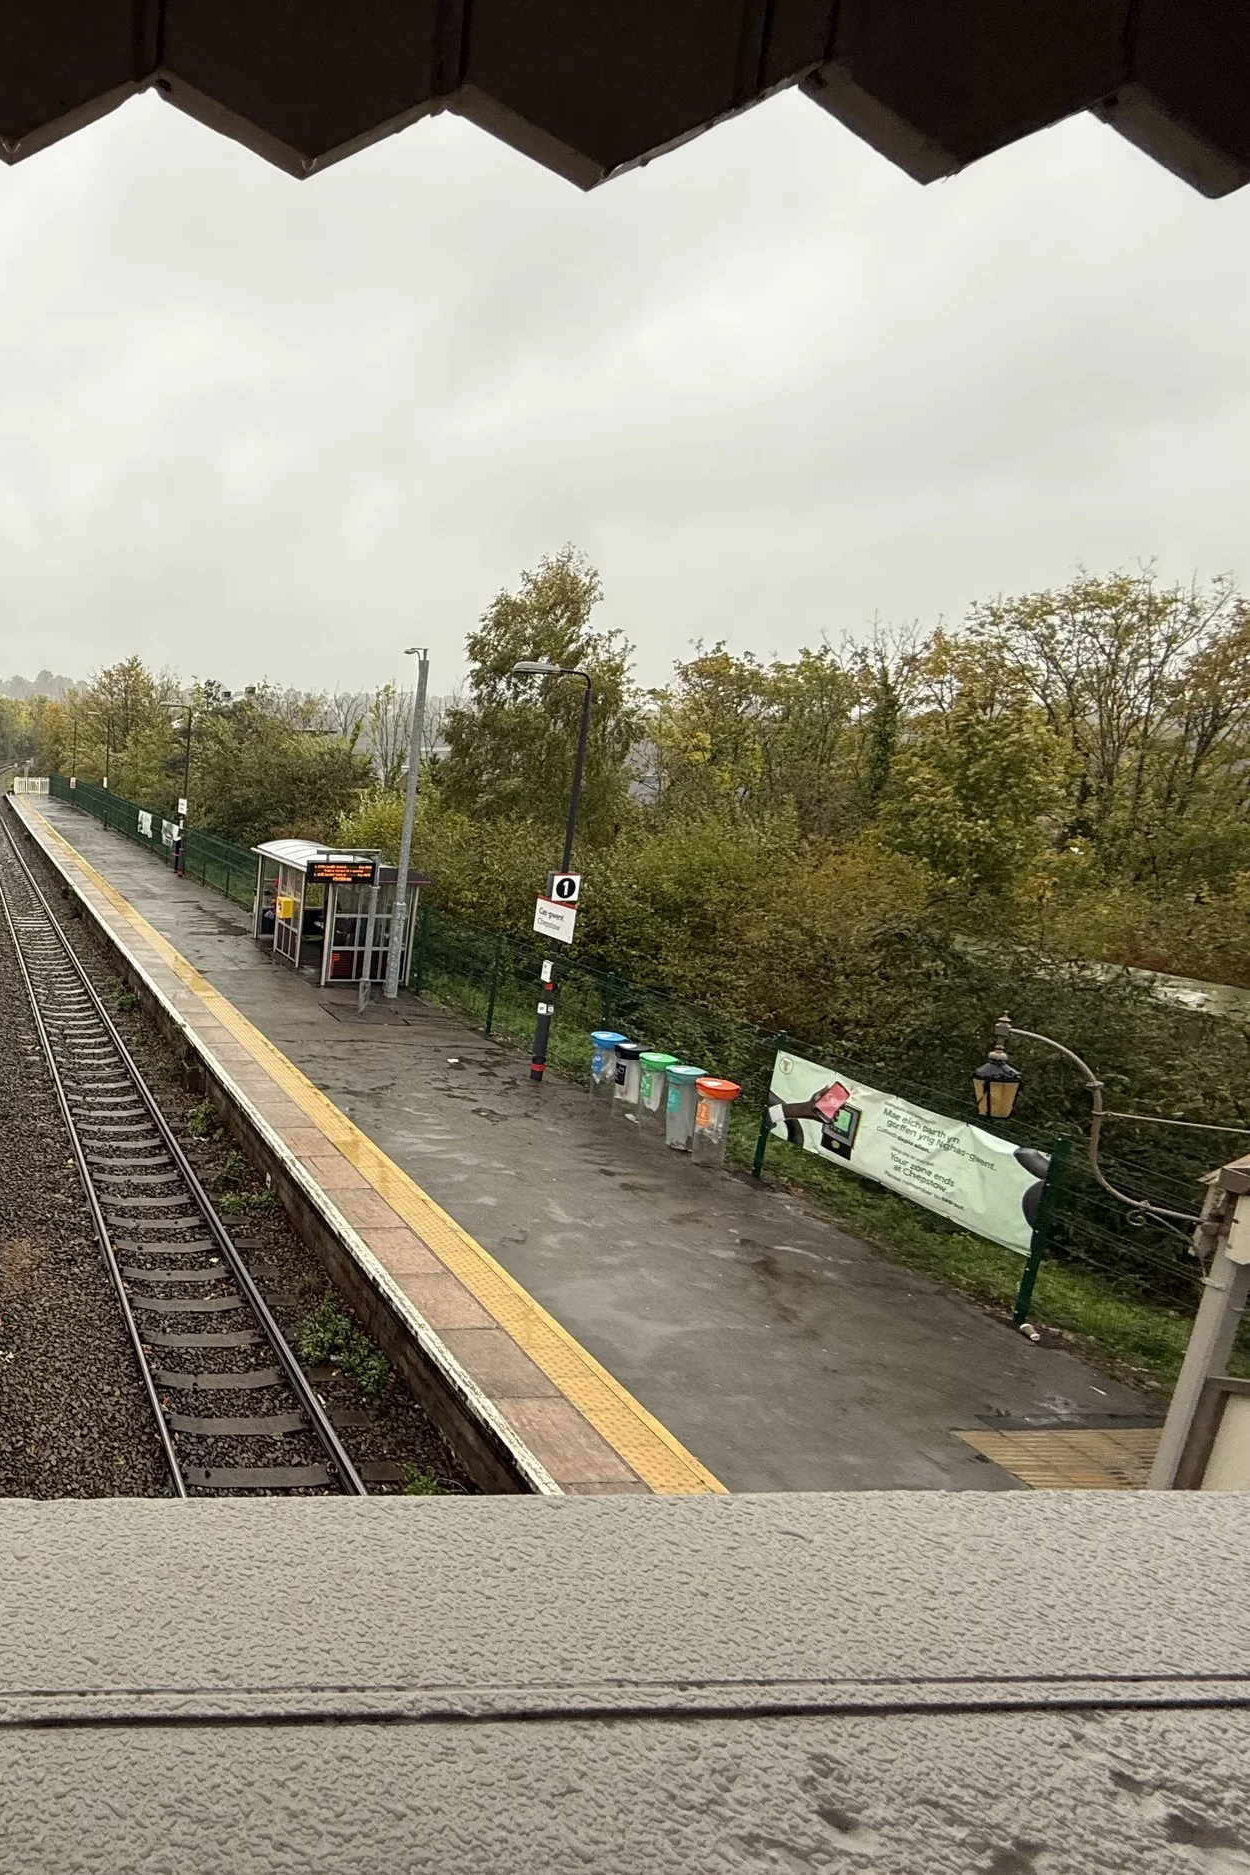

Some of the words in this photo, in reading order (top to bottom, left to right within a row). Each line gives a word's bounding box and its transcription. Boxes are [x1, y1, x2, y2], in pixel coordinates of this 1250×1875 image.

[562, 880, 570, 896] 1
[538, 918, 560, 931] Chepstow
[883, 1108, 900, 1121] Mae
[902, 1116, 921, 1129] eich
[922, 1125, 946, 1139] parth
[947, 1135, 960, 1145] yn
[886, 1119, 917, 1137] gorffen
[918, 1133, 935, 1146] yng
[890, 1153, 909, 1166] Your
[910, 1164, 932, 1176] zone
[934, 1173, 955, 1187] ends
[893, 1164, 902, 1173] at
